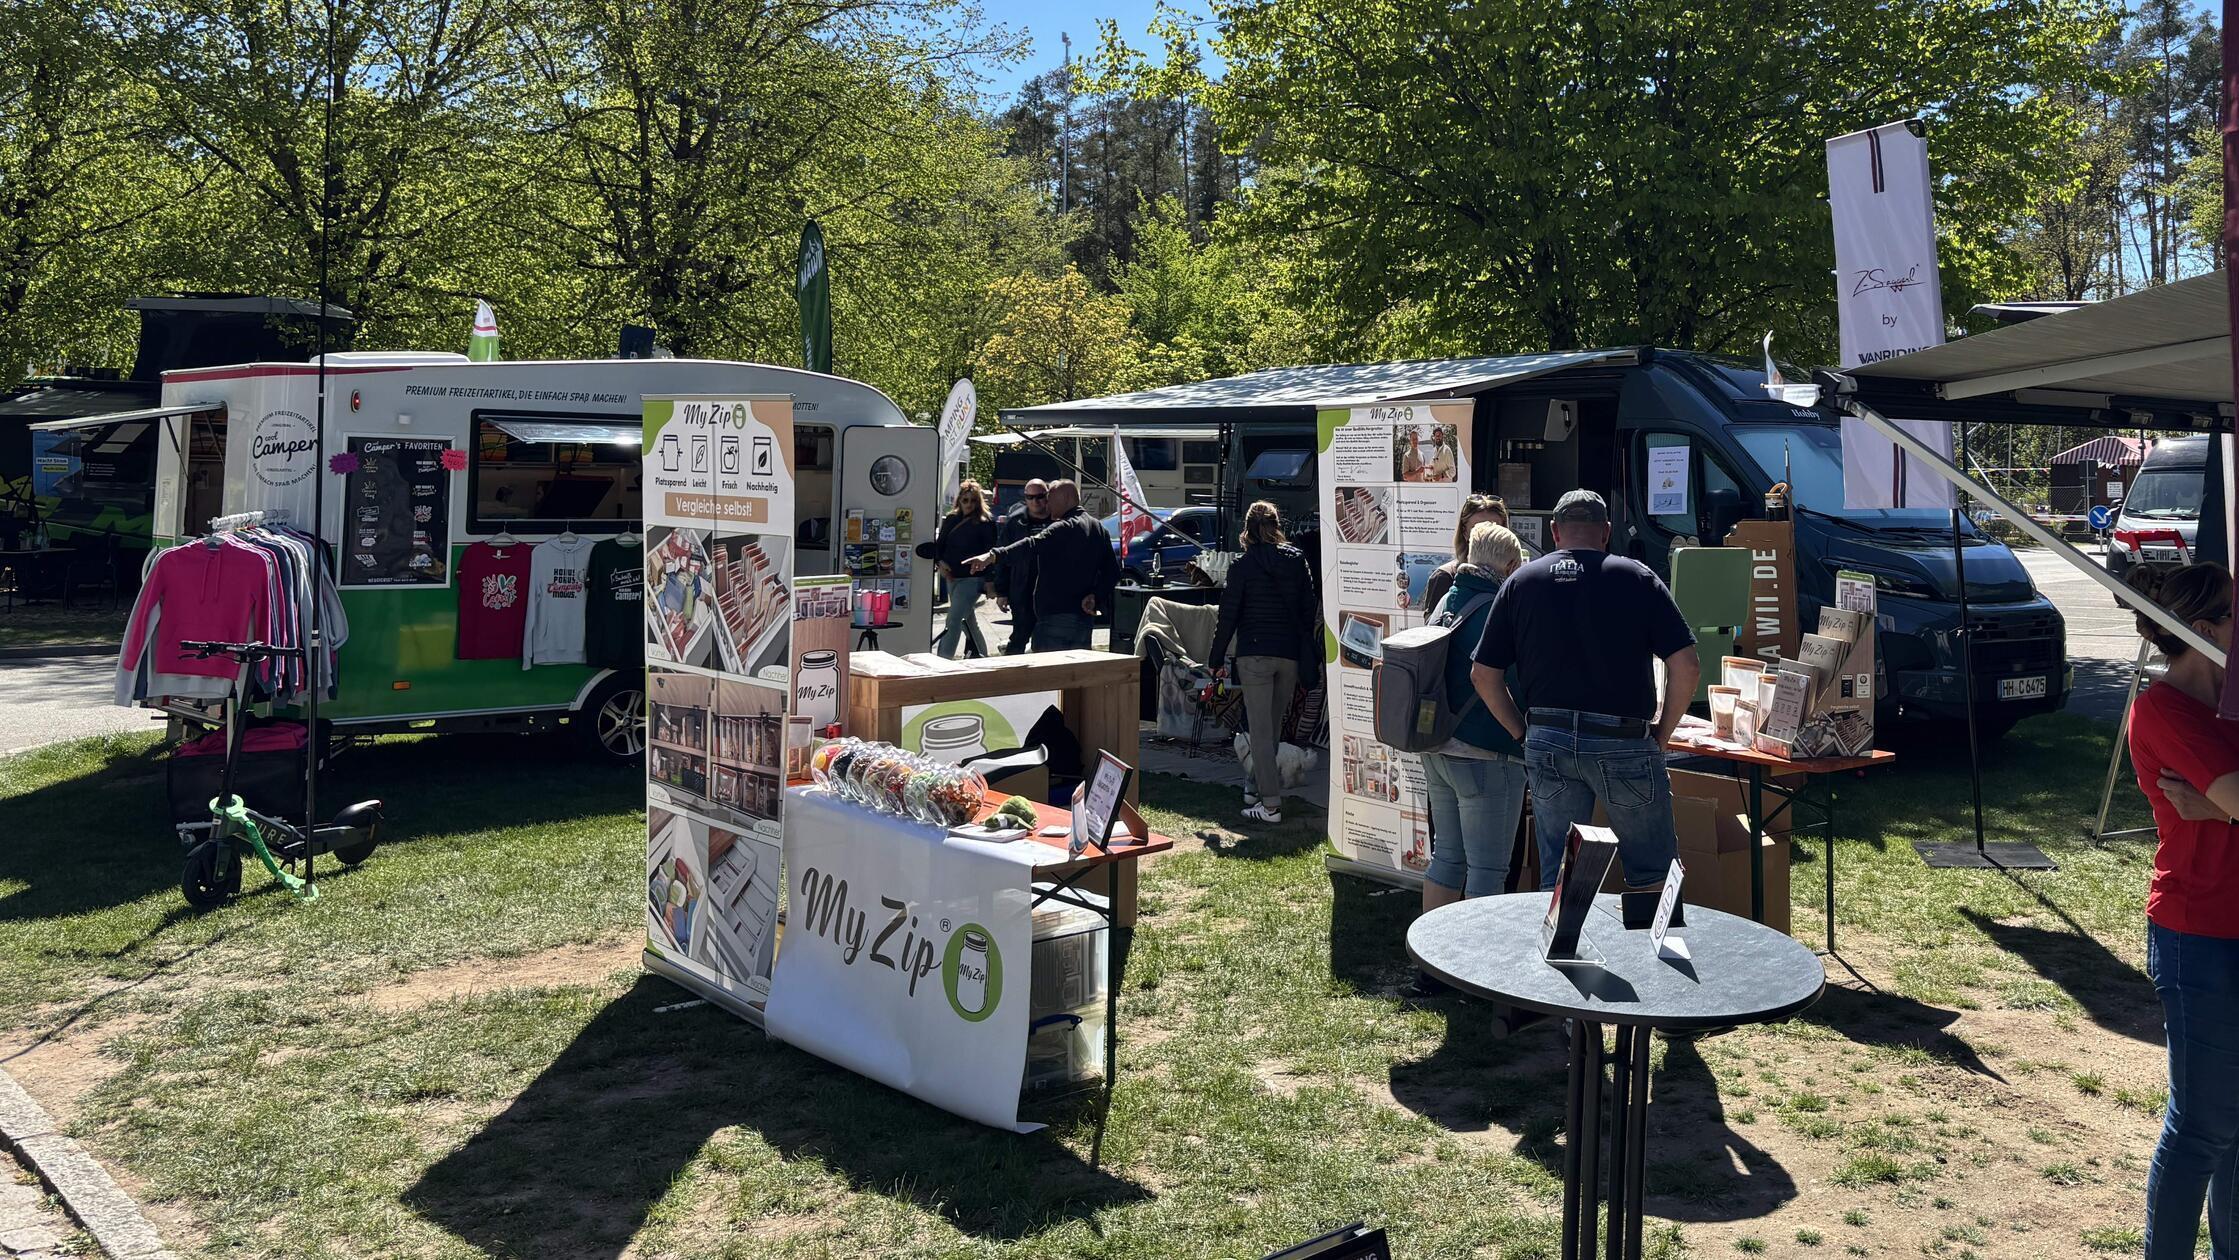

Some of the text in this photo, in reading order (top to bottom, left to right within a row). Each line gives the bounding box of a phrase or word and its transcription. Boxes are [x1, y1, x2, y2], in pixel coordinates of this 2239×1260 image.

[1882, 313, 1898, 328] by
[405, 385, 447, 397] PREMIUM
[534, 391, 568, 401] EINFACH
[591, 392, 628, 404] MACHEN!
[1791, 409, 1821, 421] Hobby
[252, 435, 319, 462] Camper
[364, 442, 443, 454] Camper's FAVORITEN
[655, 477, 687, 488] Platzsparend
[692, 478, 707, 488] Leicht
[722, 480, 738, 490] Frisch
[746, 482, 778, 494] Nachhaltig
[676, 497, 752, 517] Vergleiche selbst!
[2003, 680, 2014, 697] HH
[251, 819, 287, 845] URE
